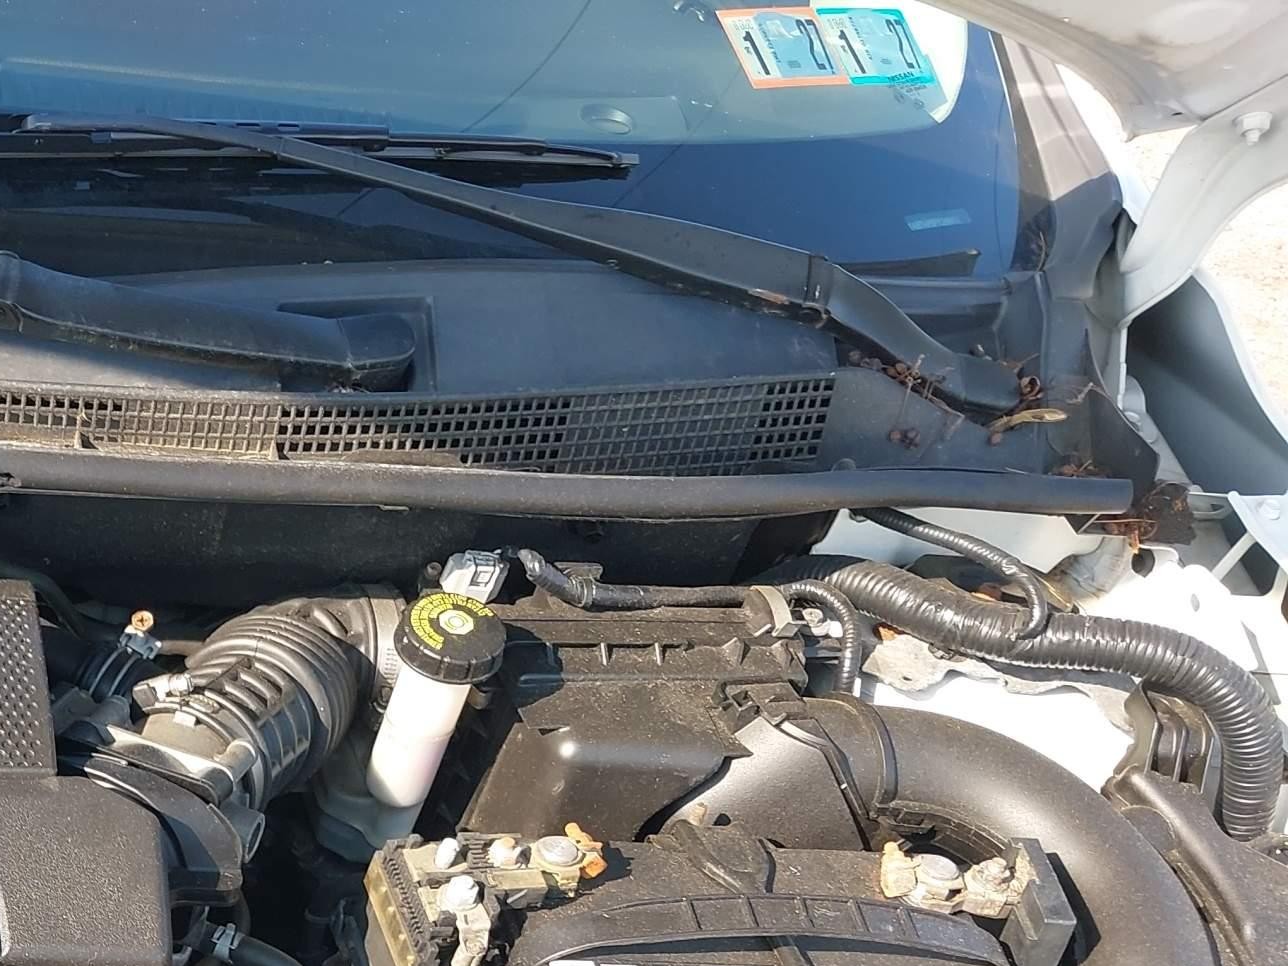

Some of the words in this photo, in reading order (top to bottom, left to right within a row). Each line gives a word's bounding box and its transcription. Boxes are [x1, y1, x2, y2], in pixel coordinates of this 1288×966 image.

[743, 30, 771, 76] 1
[795, 18, 836, 75] 27
[838, 29, 867, 74] 1
[885, 18, 923, 74] 27
